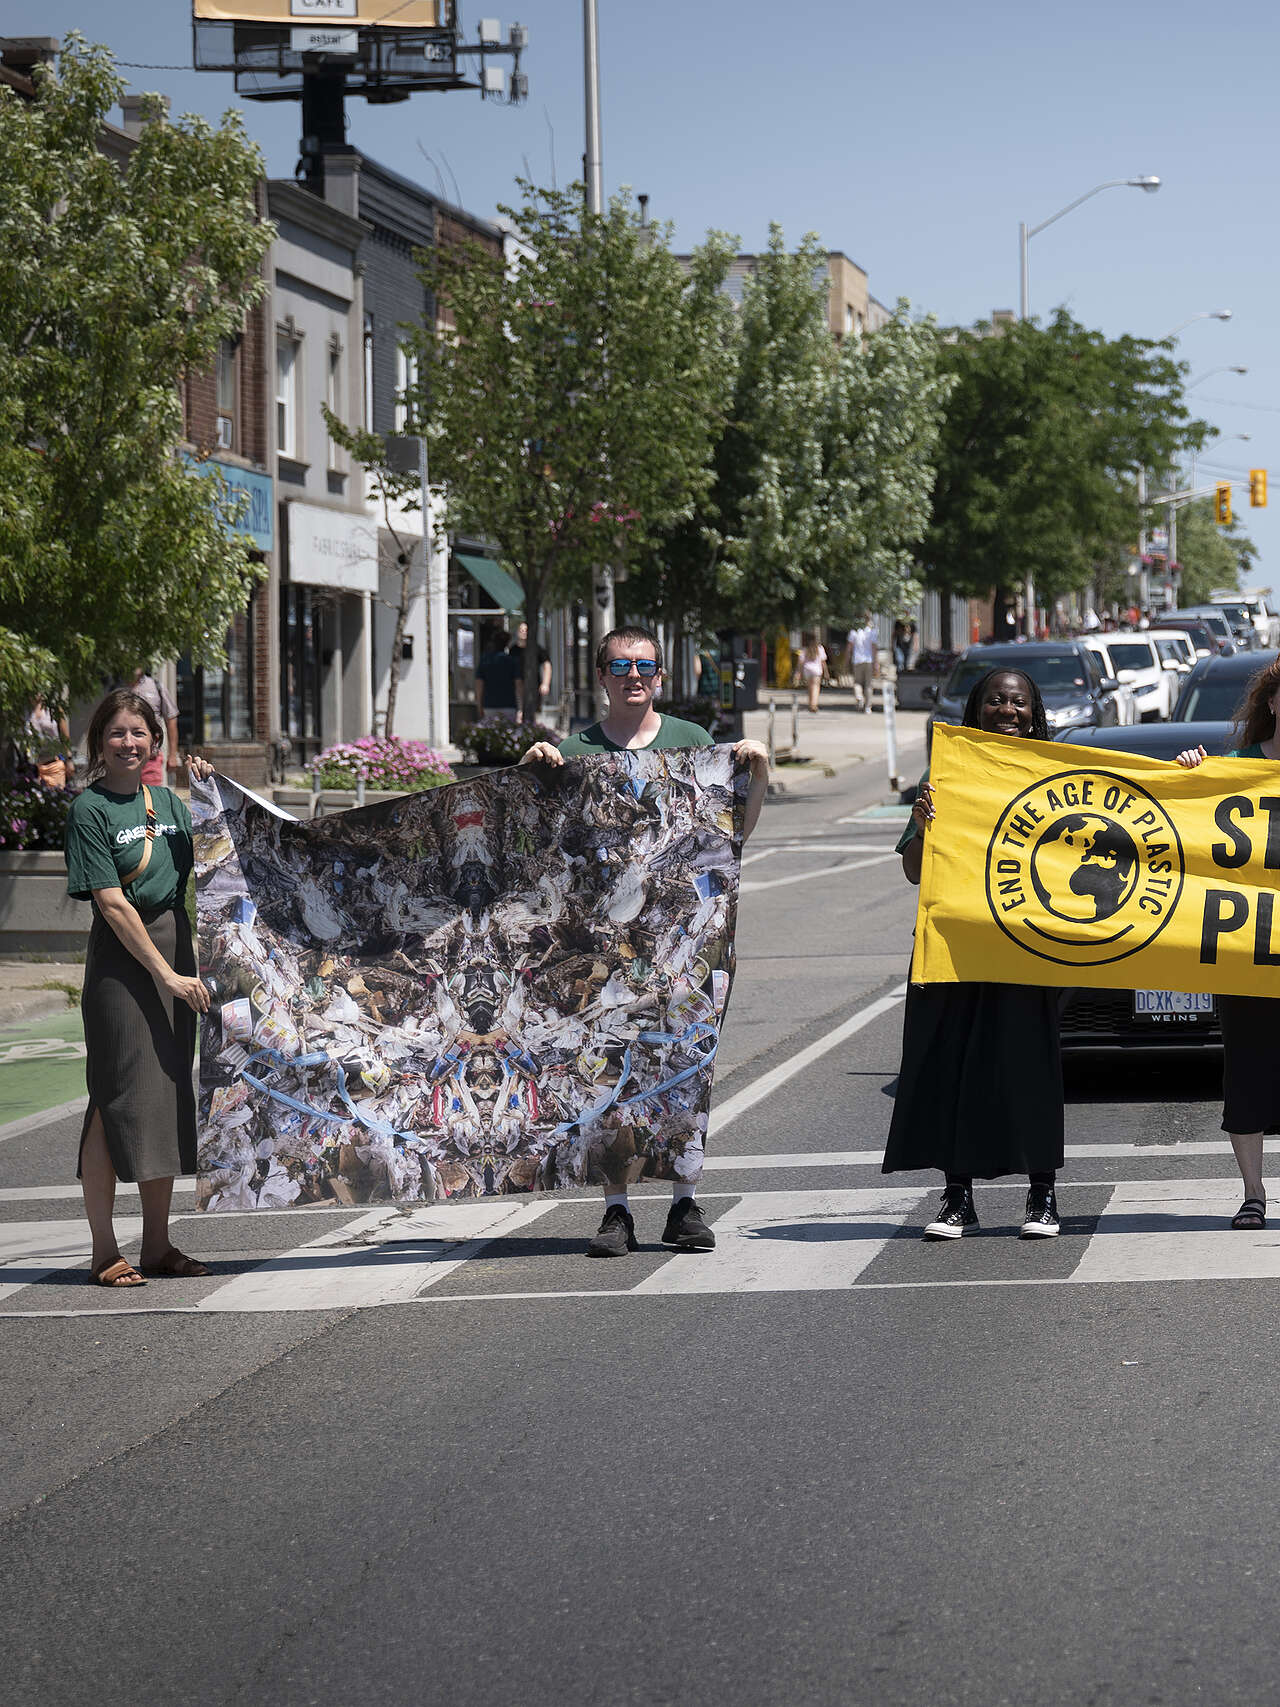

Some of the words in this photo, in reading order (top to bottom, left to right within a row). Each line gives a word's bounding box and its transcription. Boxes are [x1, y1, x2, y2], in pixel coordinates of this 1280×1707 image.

[1046, 781, 1094, 811] AGE
[1103, 786, 1136, 814] OF
[1002, 801, 1045, 848] THE
[1132, 810, 1173, 915] PLASTIC
[997, 859, 1027, 912] END
[1151, 1014, 1198, 1022] WEINS
